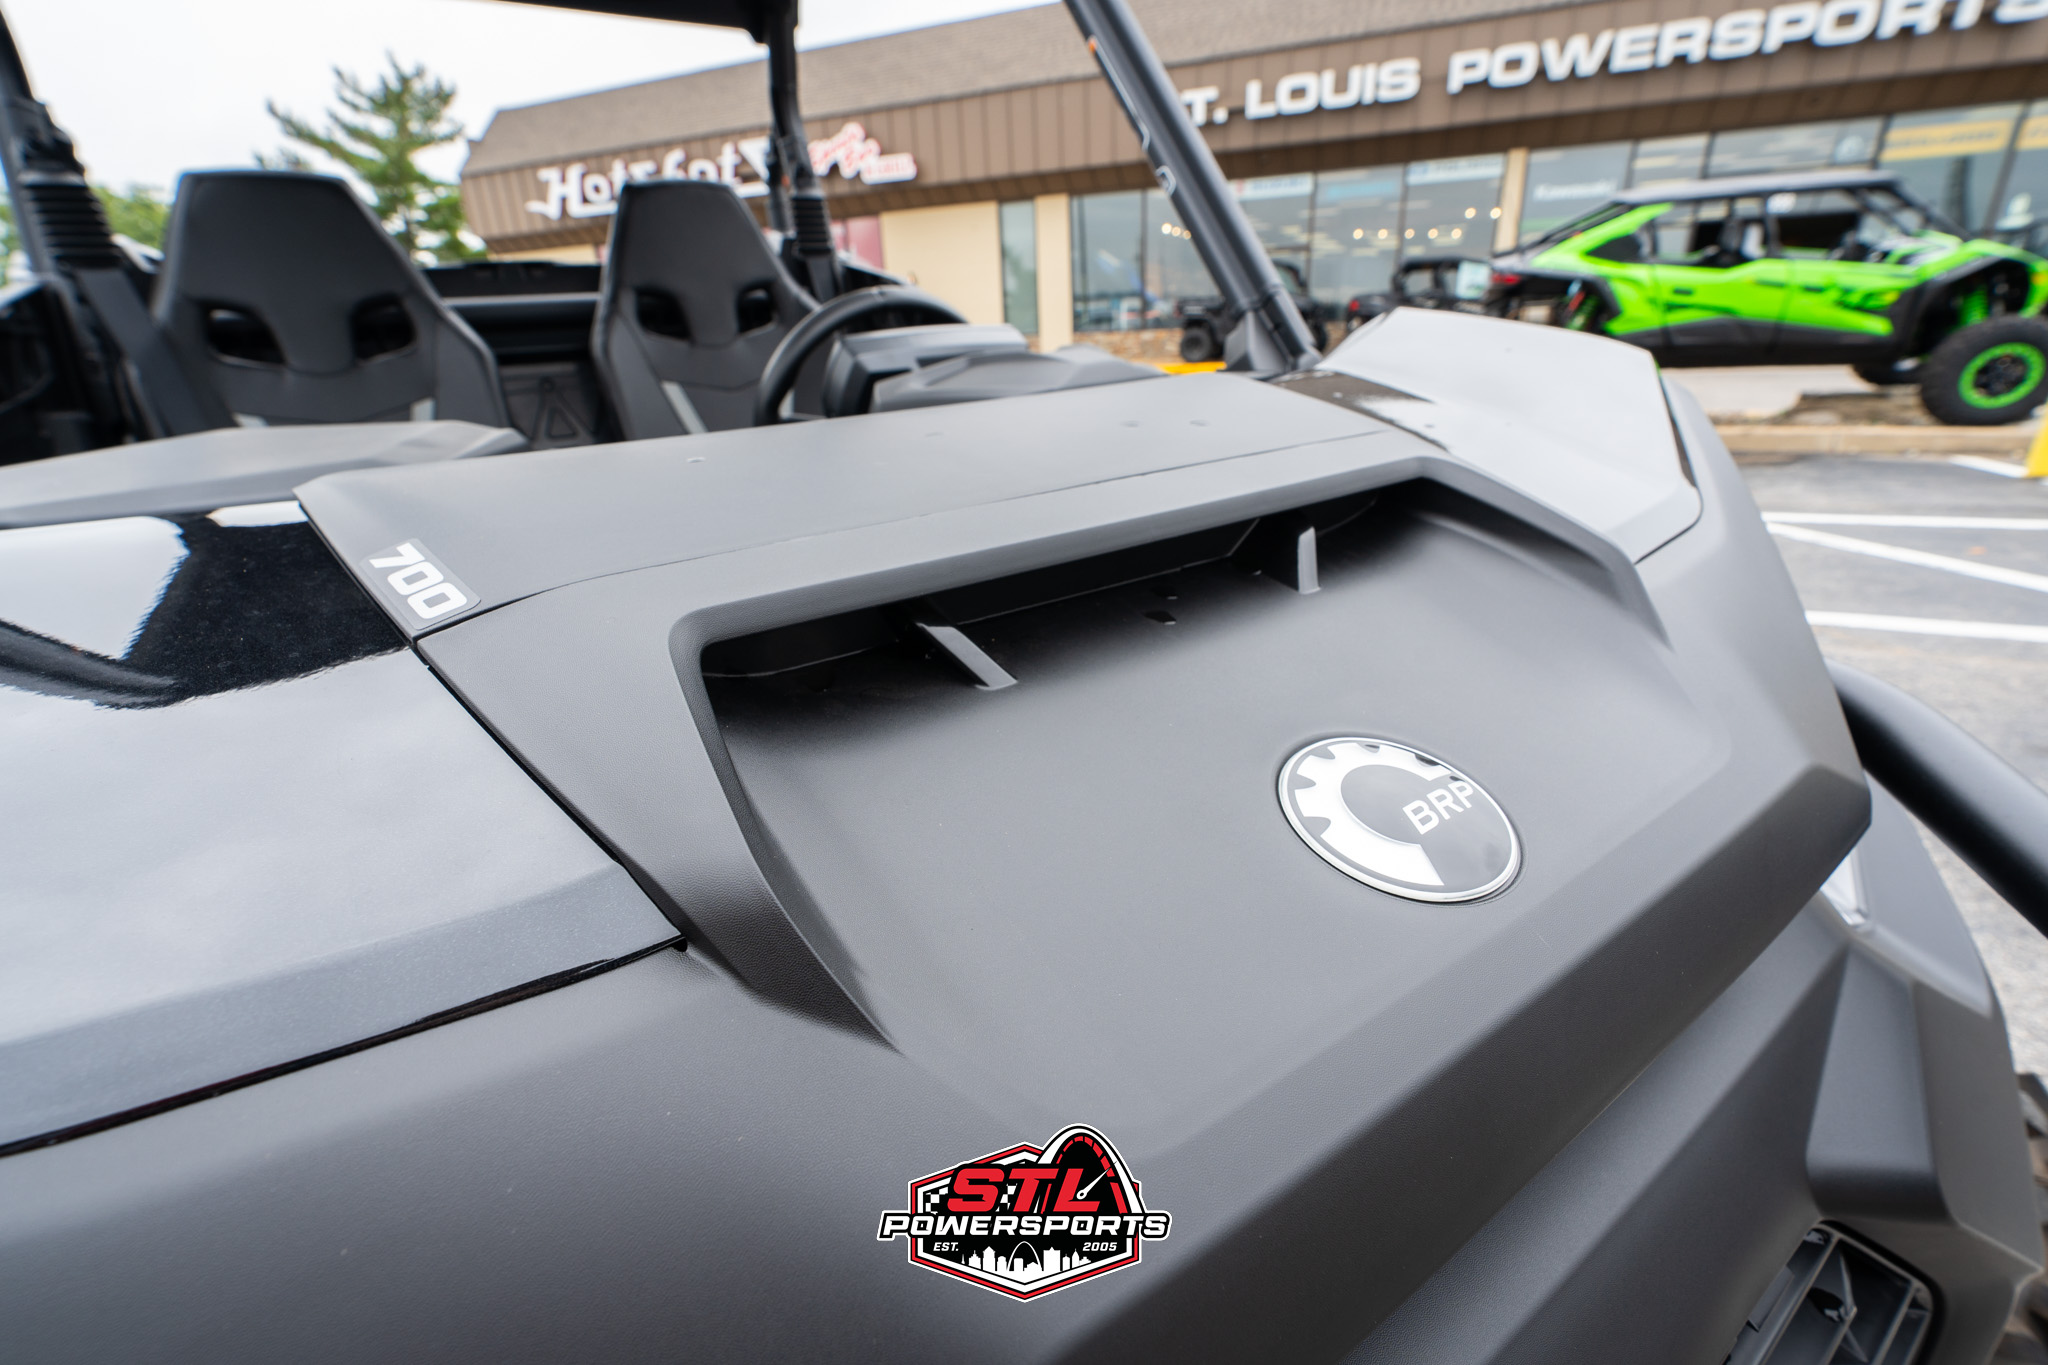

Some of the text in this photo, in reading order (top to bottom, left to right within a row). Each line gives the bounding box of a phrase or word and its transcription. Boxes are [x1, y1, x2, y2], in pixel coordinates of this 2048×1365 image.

[1245, 57, 1421, 120] LOUIS
[369, 542, 467, 619] 700
[1402, 781, 1474, 835] BRP
